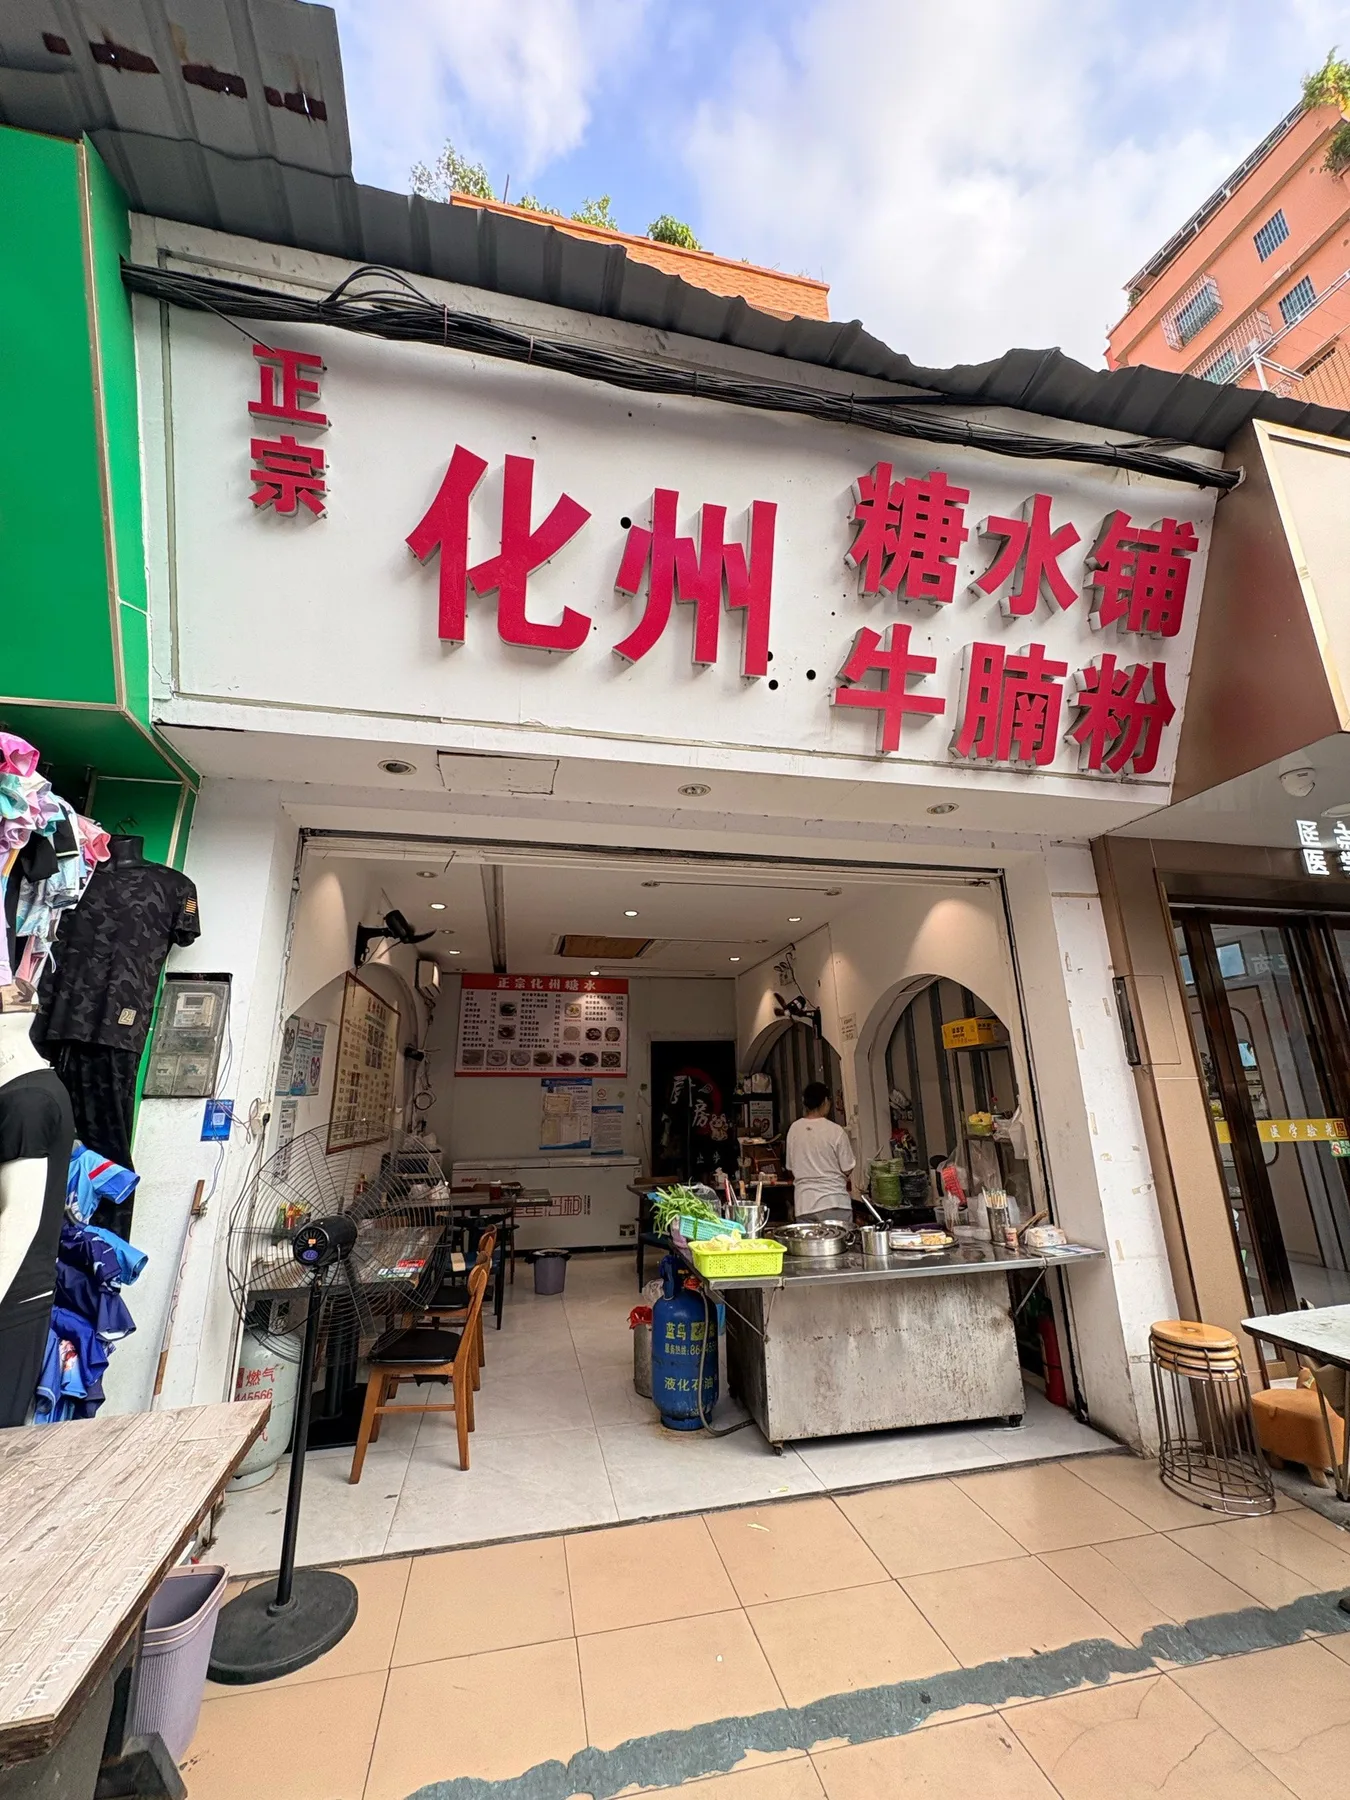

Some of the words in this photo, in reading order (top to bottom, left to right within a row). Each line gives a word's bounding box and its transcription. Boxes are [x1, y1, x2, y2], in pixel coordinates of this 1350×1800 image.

[248, 344, 330, 519] 正宗
[405, 443, 778, 678] 化州
[844, 461, 1200, 638] 糖水铺
[831, 623, 1177, 774] 牛腩粉
[497, 976, 597, 991] 正宗化州糖水
[120, 1010, 134, 1025] 24
[670, 1075, 710, 1127] 厨房
[1270, 1122, 1336, 1139] 医学验光
[665, 1322, 687, 1341] 蓝鸟
[246, 1366, 275, 1387] 燃气
